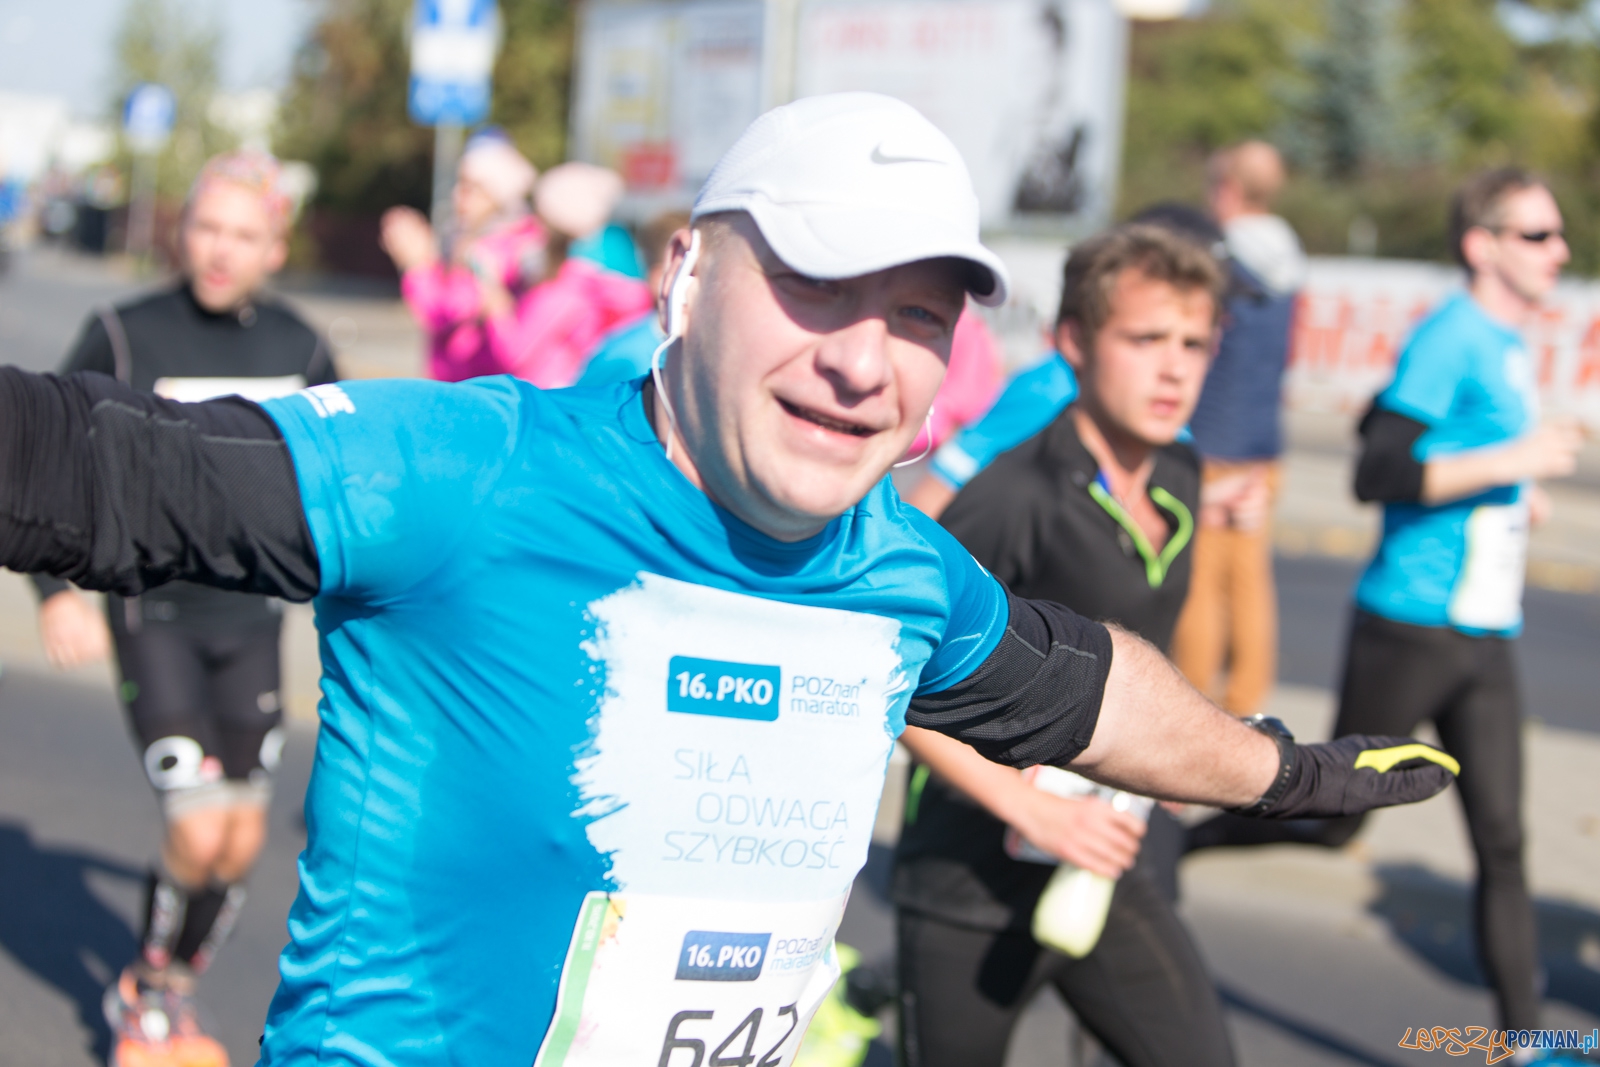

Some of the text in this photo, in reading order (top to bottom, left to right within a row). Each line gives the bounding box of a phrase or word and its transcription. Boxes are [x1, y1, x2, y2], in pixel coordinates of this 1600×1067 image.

[790, 698, 860, 718] maraton
[673, 748, 752, 784] SIŁA
[695, 791, 849, 831] ODWAGA
[661, 830, 847, 869] SZYBKOŚĆ
